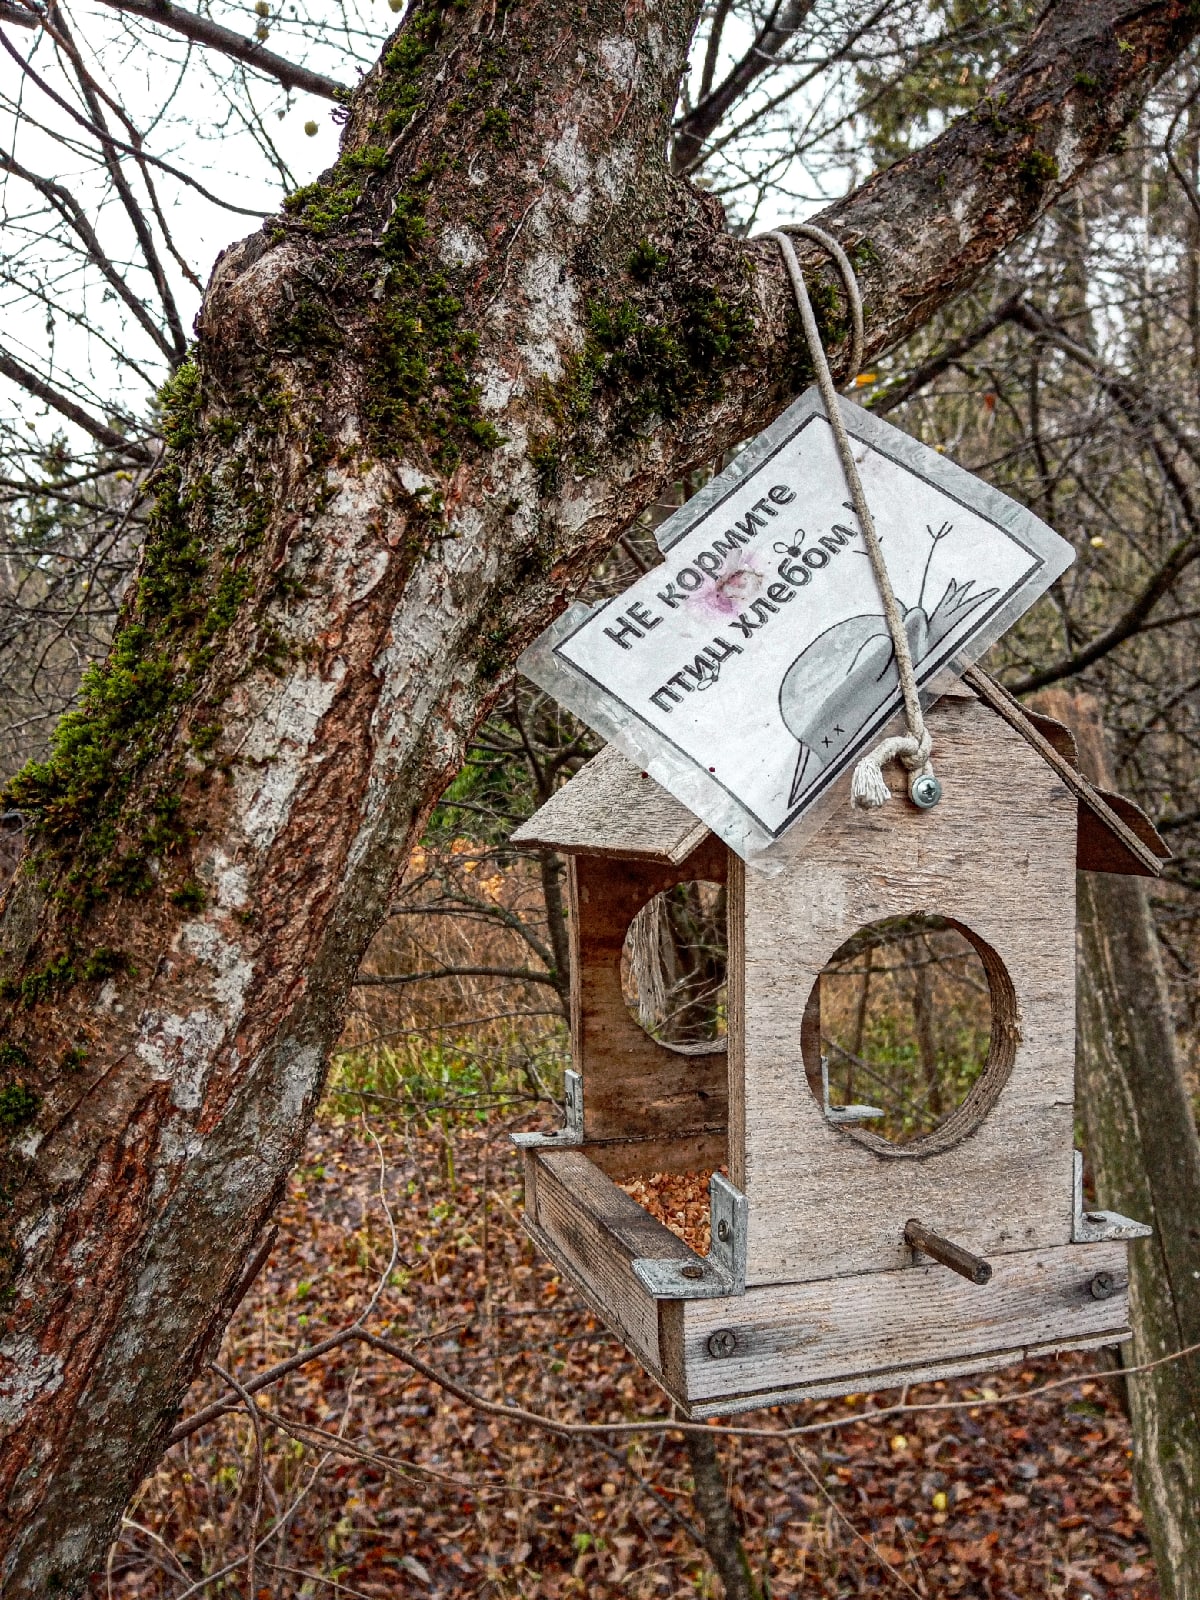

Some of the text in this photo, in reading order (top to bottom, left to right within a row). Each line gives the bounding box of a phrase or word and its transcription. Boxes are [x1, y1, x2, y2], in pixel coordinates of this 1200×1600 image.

[603, 485, 797, 650] НЕ кормите
[649, 636, 744, 713] птиц
